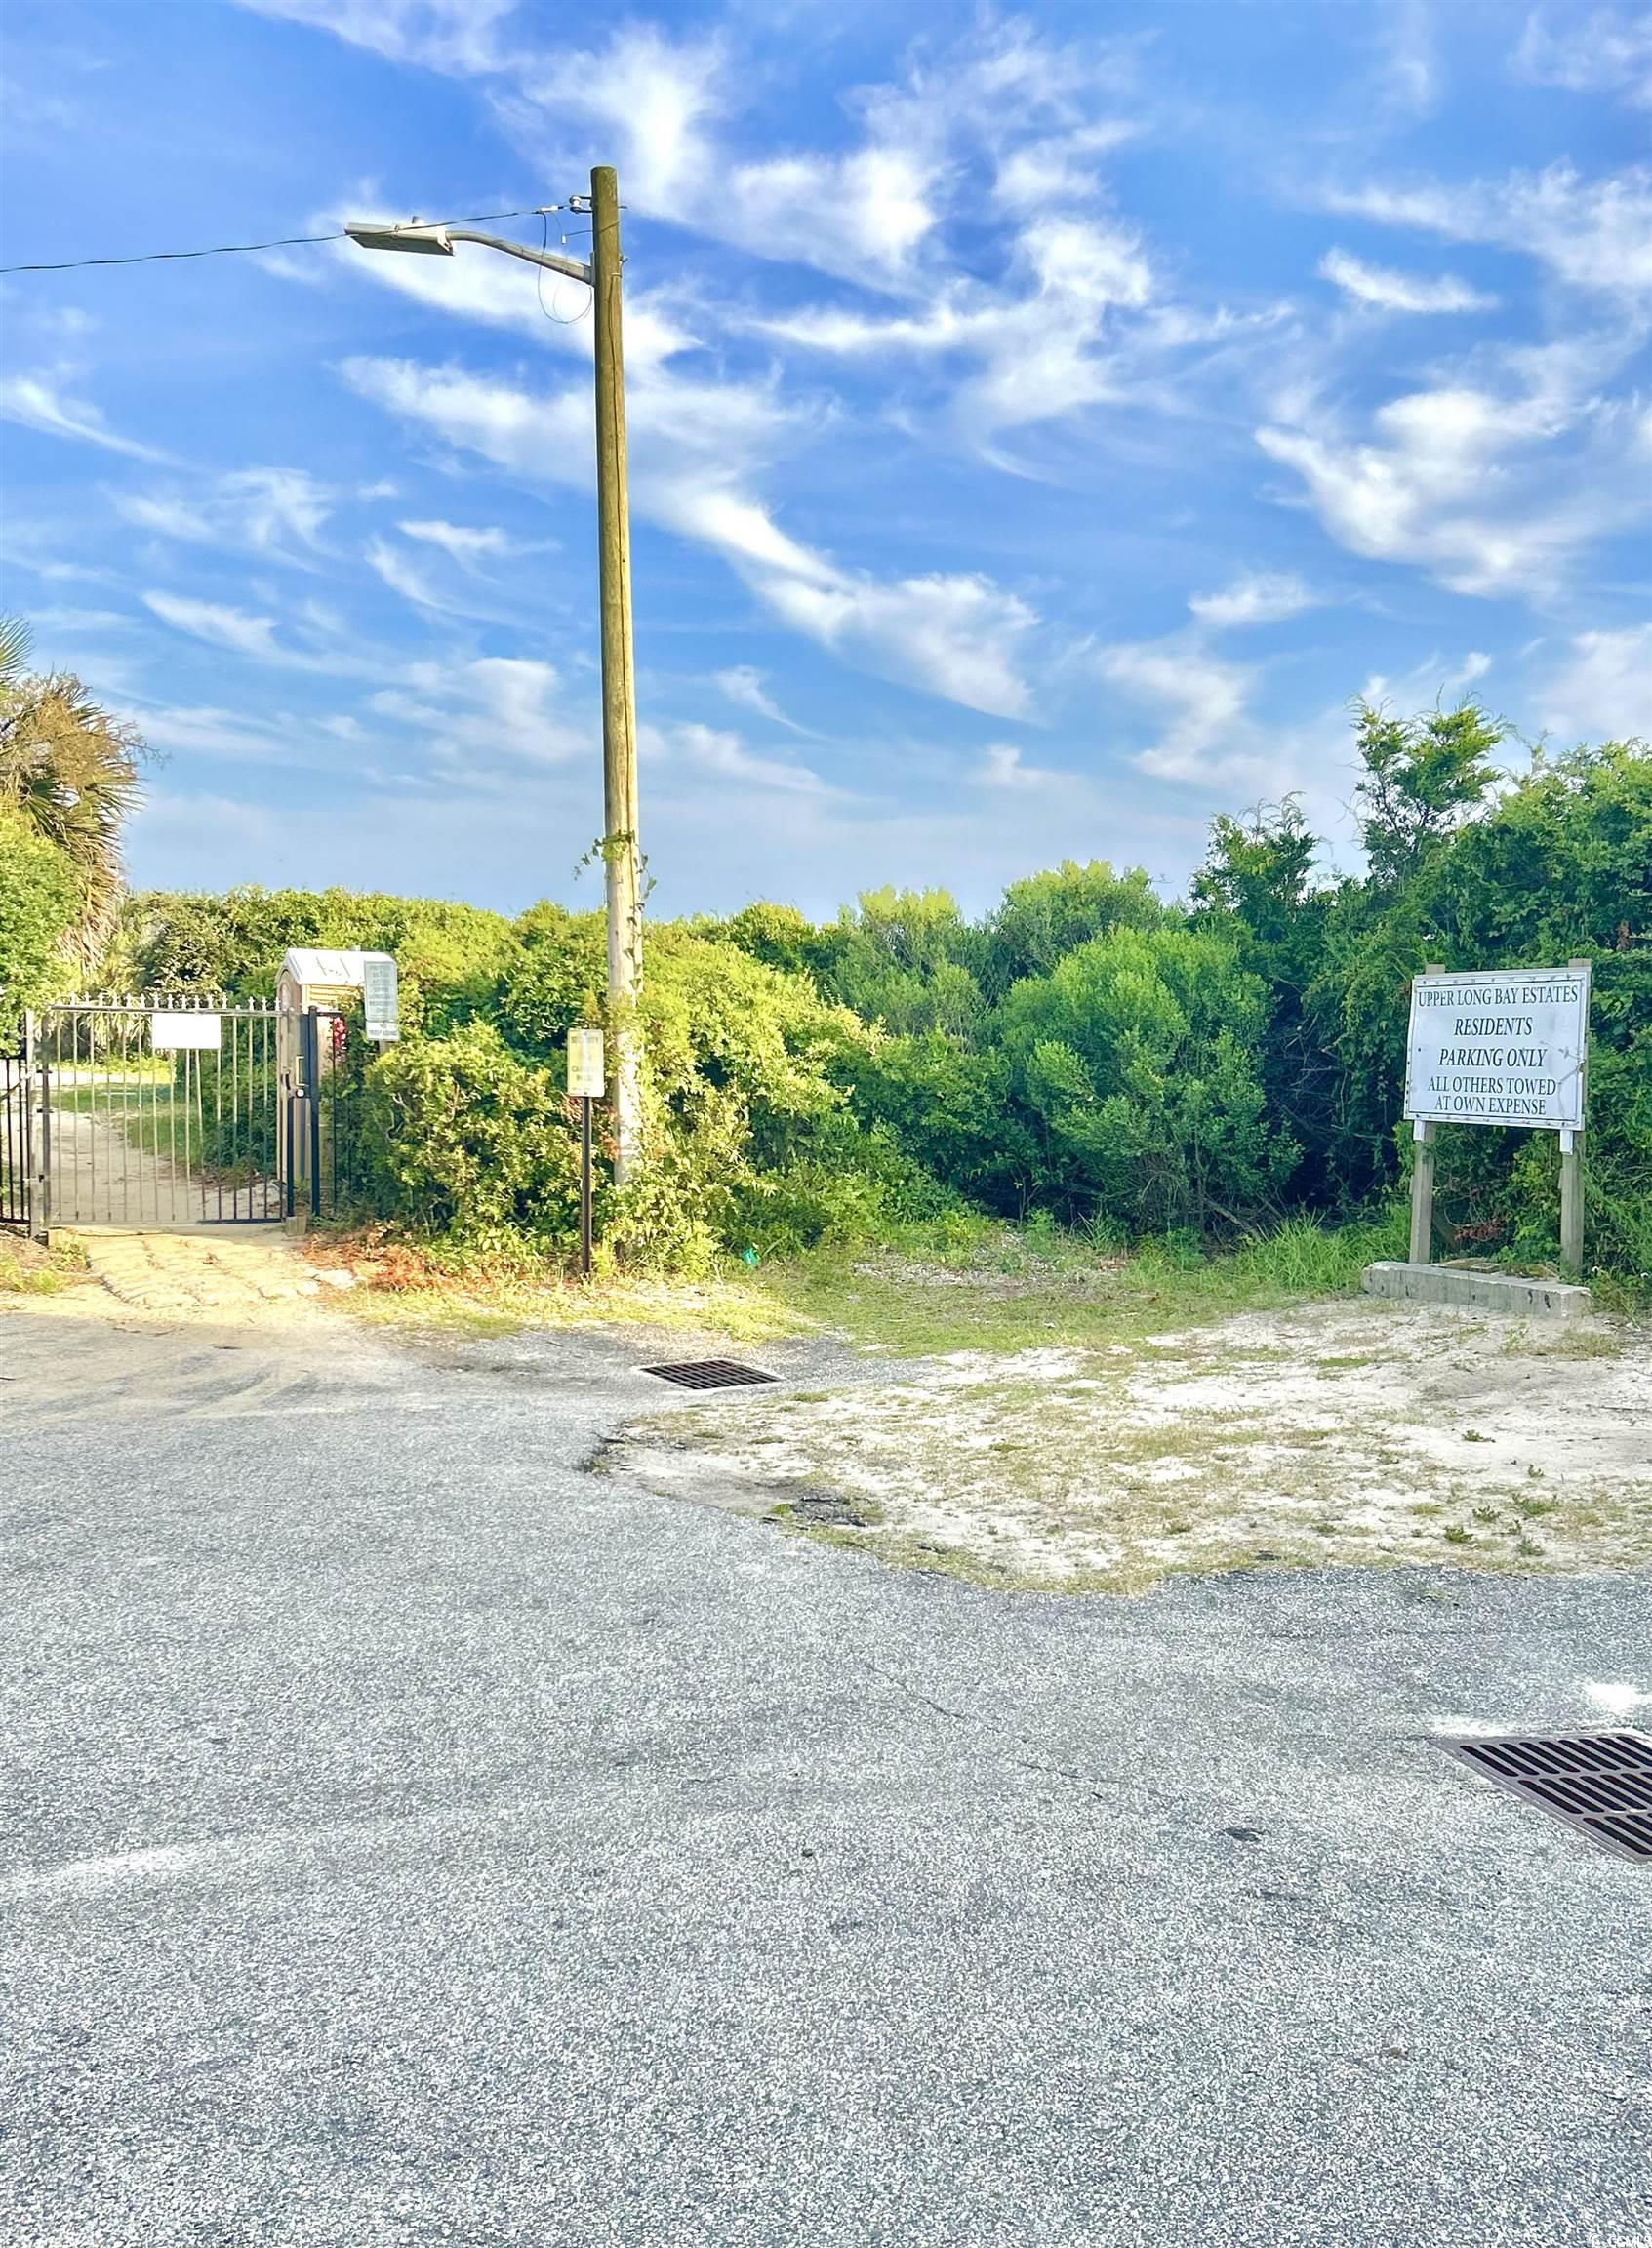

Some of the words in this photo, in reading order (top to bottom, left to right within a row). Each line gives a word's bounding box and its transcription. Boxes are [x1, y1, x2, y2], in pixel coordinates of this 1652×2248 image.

[1418, 990, 1454, 1007] UPPER
[1458, 989, 1492, 1006] LONG
[1495, 988, 1519, 1005] BAY
[1522, 986, 1578, 1003] ESTATES
[1454, 1017, 1533, 1036] RESIDENTS
[1438, 1048, 1503, 1067] PARKING
[1507, 1048, 1548, 1067] ONLY
[1429, 1076, 1450, 1091] ALL
[1452, 1077, 1504, 1094] OTHERS
[1507, 1078, 1556, 1096] TOWED
[1435, 1096, 1451, 1110] AT
[1453, 1097, 1486, 1112] OWN
[1489, 1098, 1547, 1115] EXPENSE
